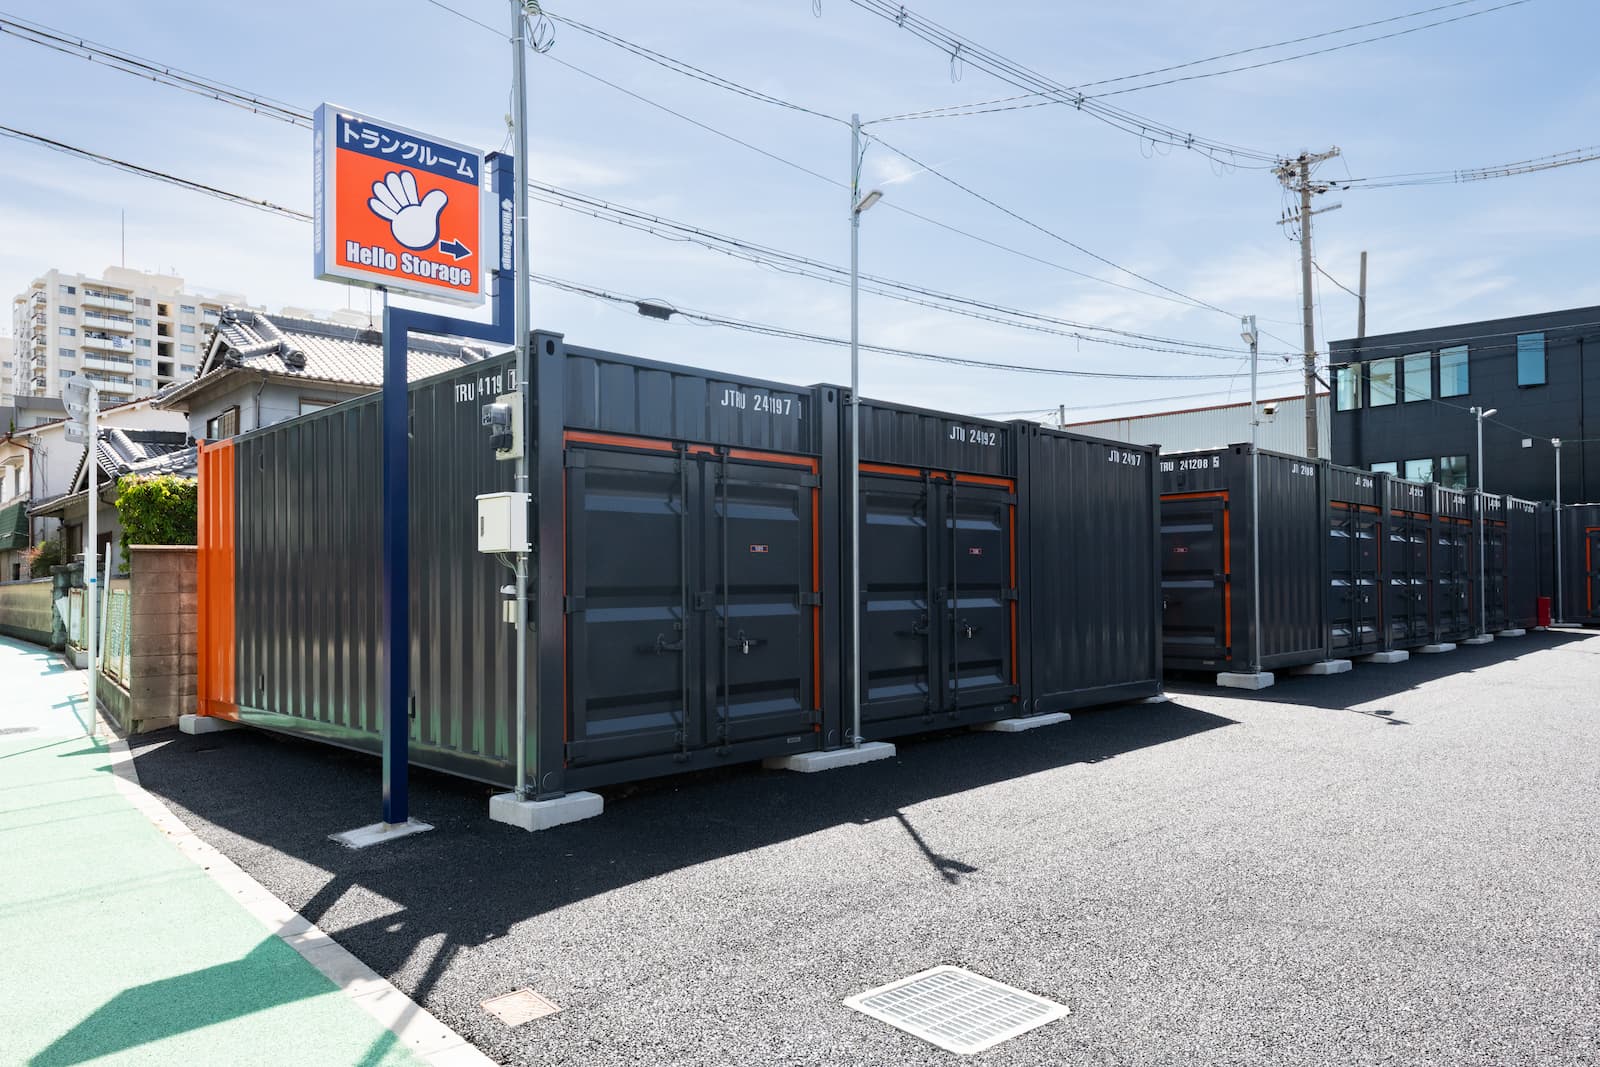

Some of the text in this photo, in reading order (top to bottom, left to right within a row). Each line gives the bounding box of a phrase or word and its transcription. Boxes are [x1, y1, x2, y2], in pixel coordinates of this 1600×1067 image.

[344, 123, 474, 178] トランクルーム
[346, 240, 471, 286] Hello Storage
[456, 382, 475, 402] TRU
[1160, 461, 1174, 473] TRU
[1179, 458, 1209, 471] 241208
